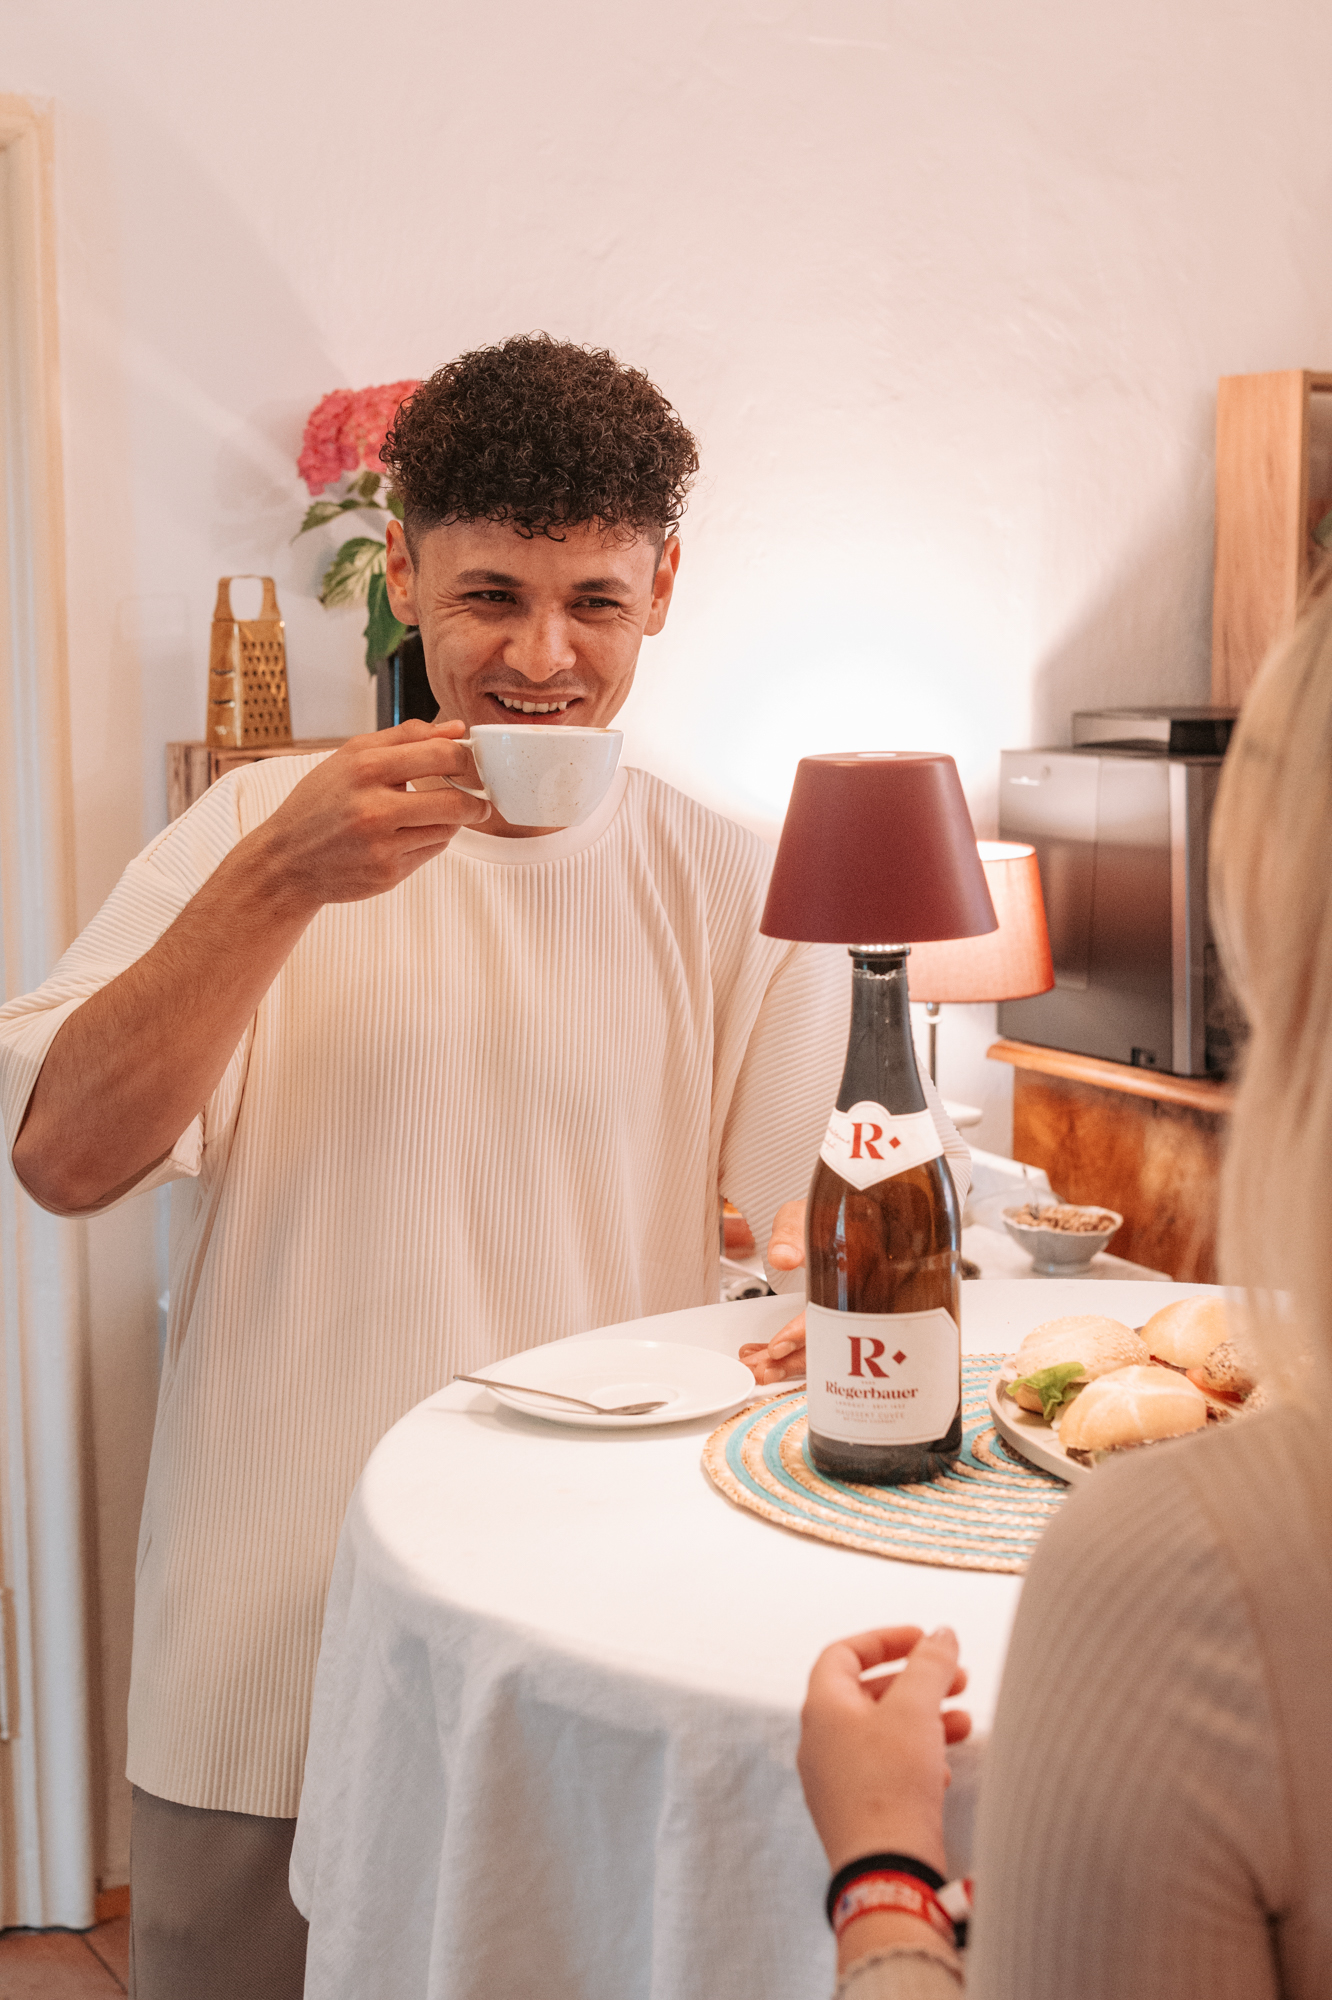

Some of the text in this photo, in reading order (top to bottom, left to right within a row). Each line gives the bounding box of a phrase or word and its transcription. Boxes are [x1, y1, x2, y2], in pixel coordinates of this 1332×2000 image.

[849, 1122, 885, 1160] R
[847, 1335, 890, 1378] R
[825, 1380, 919, 1399] Riegerbauer
